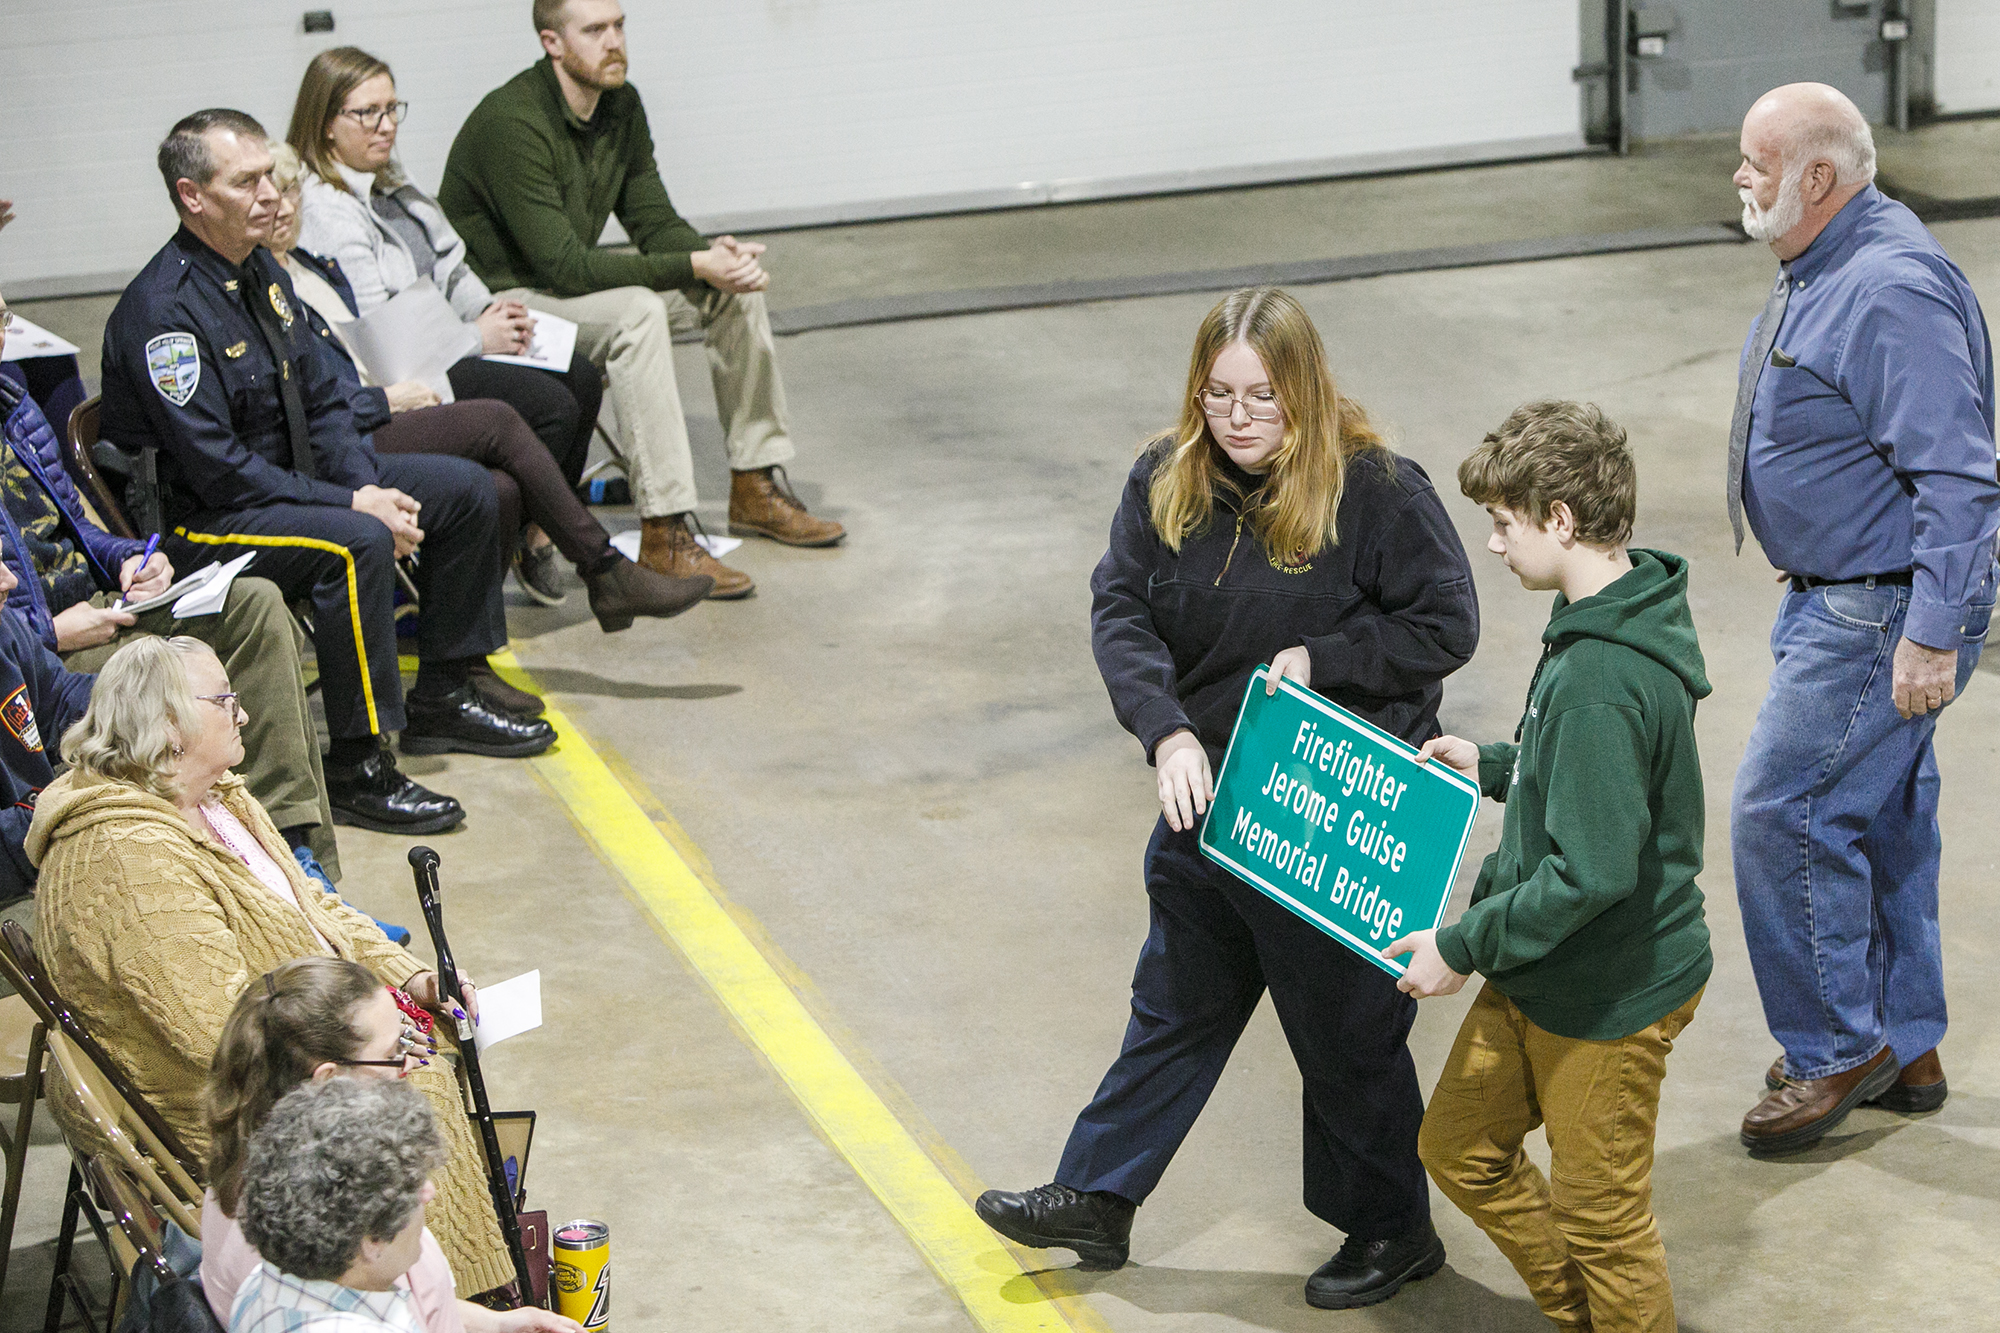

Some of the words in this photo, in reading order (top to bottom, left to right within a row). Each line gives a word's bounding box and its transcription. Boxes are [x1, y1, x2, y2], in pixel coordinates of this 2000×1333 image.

[1262, 762, 1338, 832] Jerome
[1347, 810, 1406, 872] Guise
[1292, 720, 1407, 811] Firefighter
[1231, 806, 1327, 892] Memorial
[1330, 867, 1402, 940] Bridge
